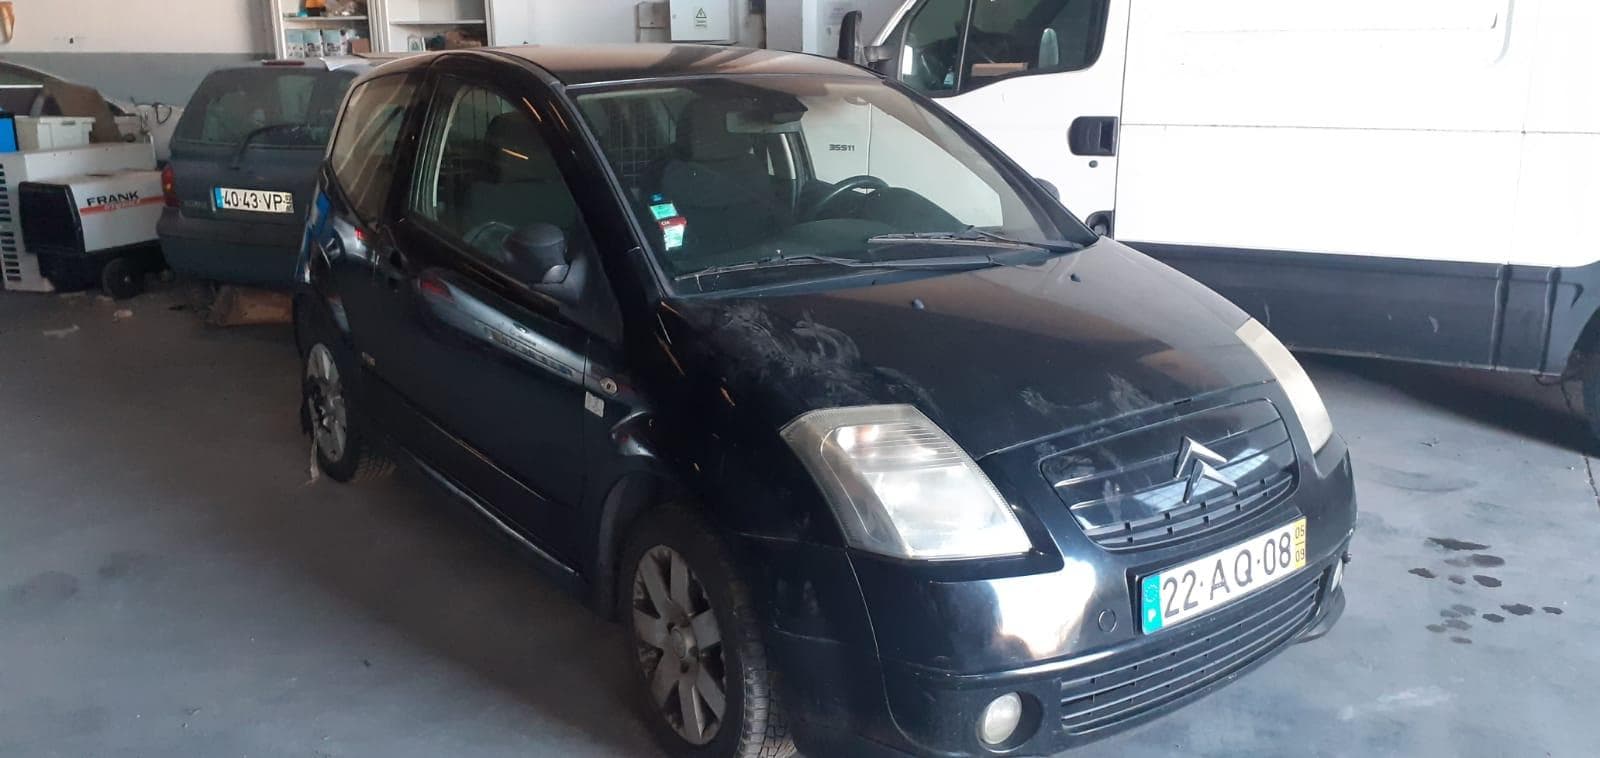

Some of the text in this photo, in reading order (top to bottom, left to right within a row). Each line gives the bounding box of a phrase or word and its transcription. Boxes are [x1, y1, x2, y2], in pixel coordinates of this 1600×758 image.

[86, 191, 139, 206] FRANK
[1295, 526, 1305, 540] 05
[1295, 549, 1306, 563] 09
